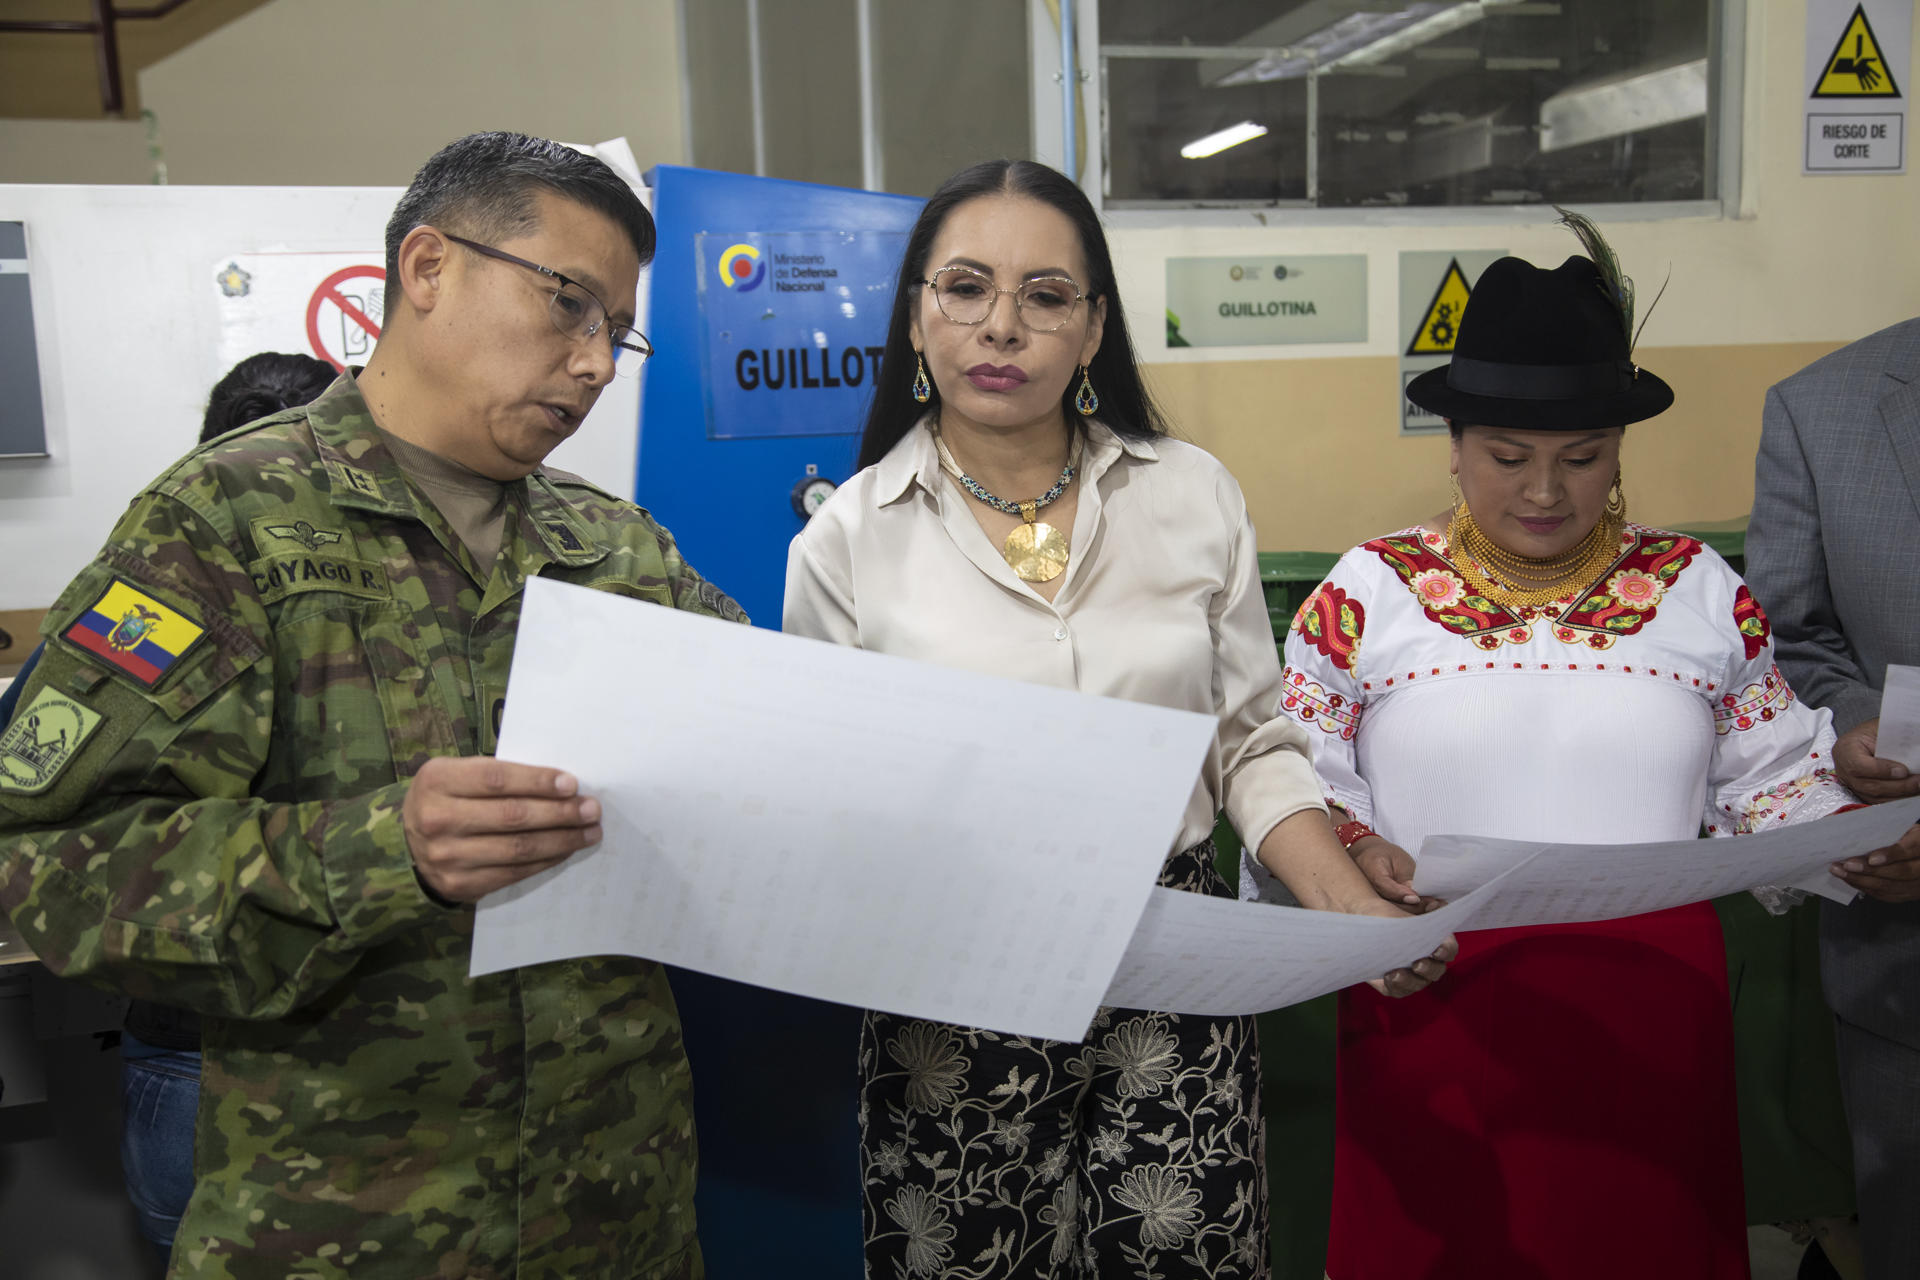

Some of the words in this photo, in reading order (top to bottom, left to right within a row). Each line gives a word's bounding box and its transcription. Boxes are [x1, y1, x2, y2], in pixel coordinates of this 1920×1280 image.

[1822, 124, 1867, 139] RIESGO
[1870, 124, 1887, 139] DE
[1833, 144, 1870, 159] CORTE
[774, 254, 825, 265] Ministerio
[775, 269, 789, 279] de
[791, 267, 838, 279] Defensa
[776, 281, 825, 292] Nacional
[1218, 301, 1317, 318] GUILLOTINA
[252, 558, 351, 594] COYAGO
[360, 568, 384, 590] R.
